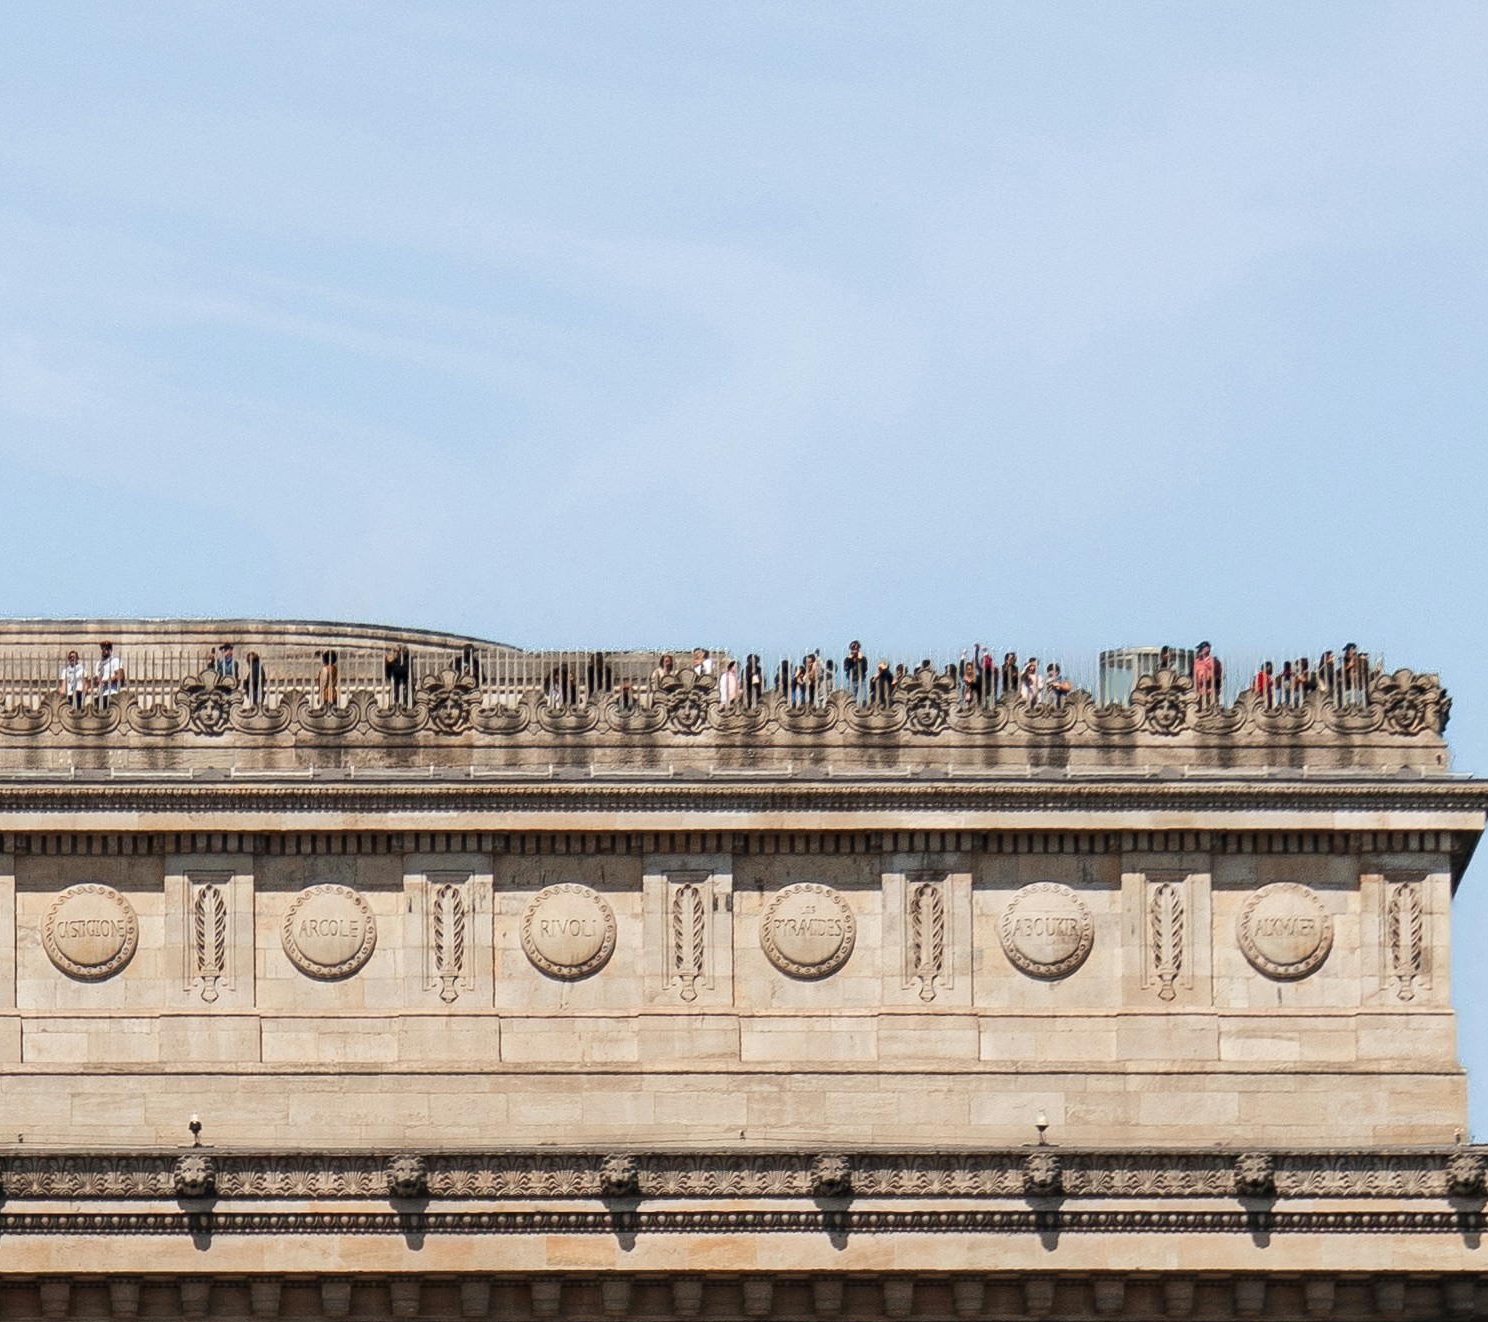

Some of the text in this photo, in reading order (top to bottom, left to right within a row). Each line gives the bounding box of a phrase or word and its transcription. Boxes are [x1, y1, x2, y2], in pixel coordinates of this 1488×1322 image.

[298, 919, 358, 938] ARCOLE
[539, 919, 597, 938] RIVOLI
[773, 918, 842, 938] PYRAMIDES
[1011, 918, 1079, 938] ABOUKIR
